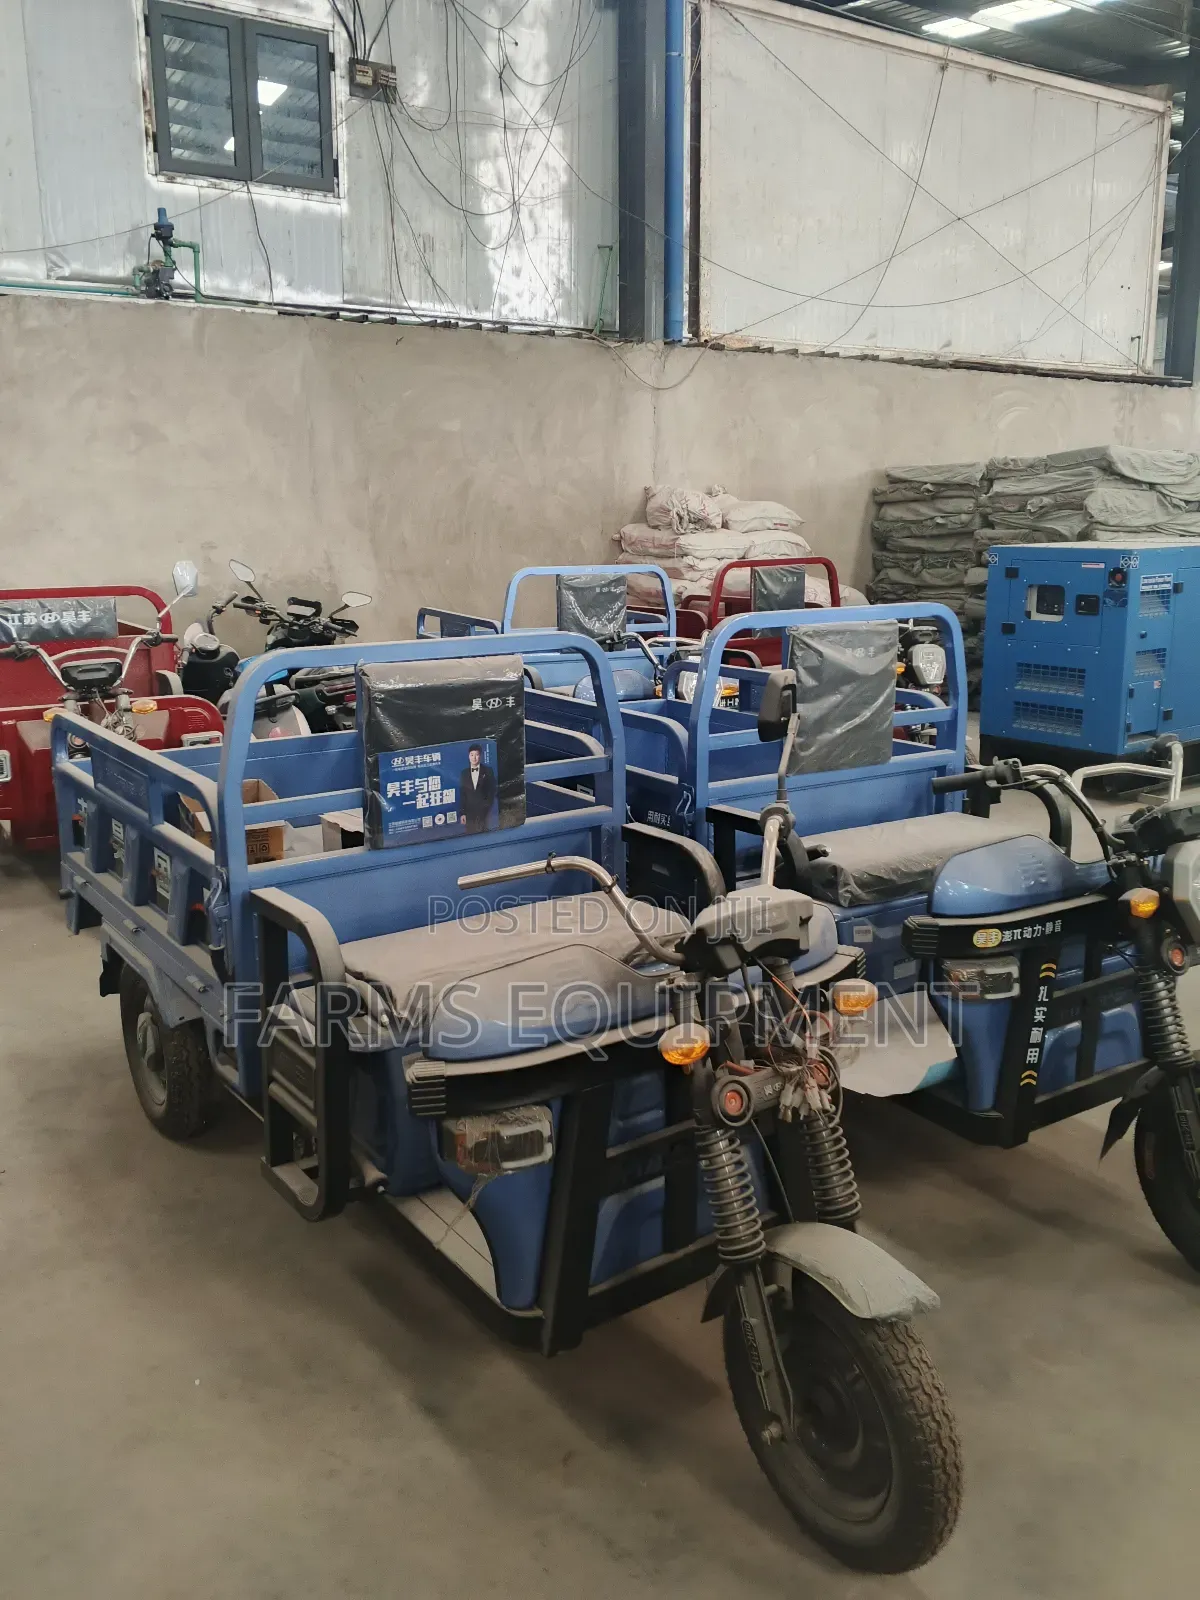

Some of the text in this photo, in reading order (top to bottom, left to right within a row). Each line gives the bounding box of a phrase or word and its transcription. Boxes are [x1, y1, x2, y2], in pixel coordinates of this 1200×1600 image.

[8, 610, 92, 625] 江苏 昊丰
[1026, 985, 1050, 1065] 扎实耐用
